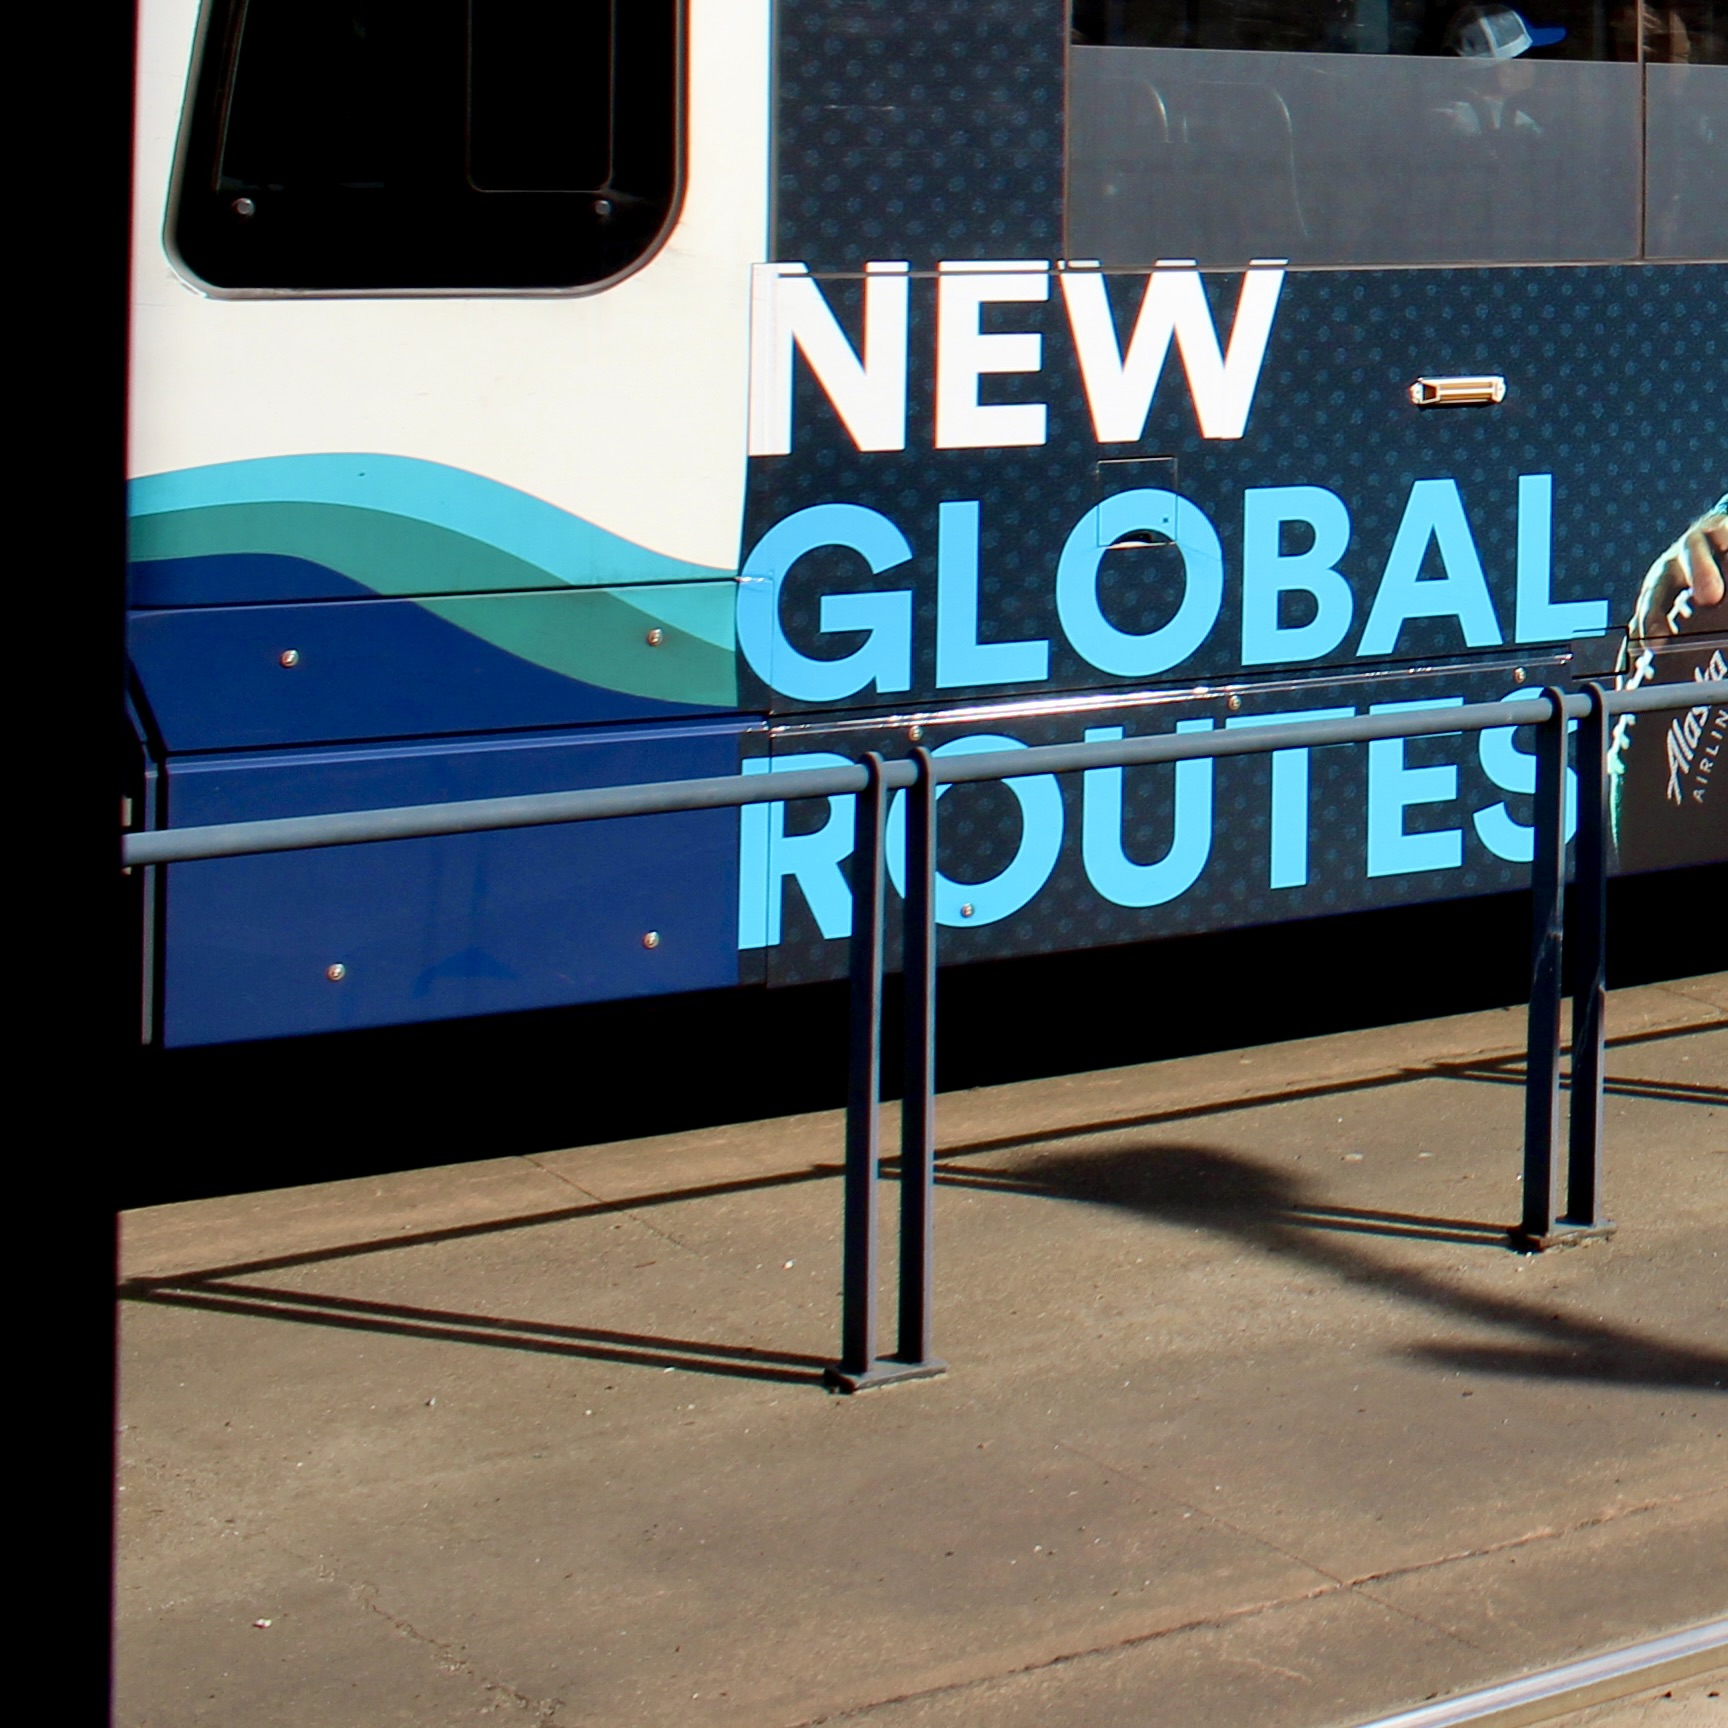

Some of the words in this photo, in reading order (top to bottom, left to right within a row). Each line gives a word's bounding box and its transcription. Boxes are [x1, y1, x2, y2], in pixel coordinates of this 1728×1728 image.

[748, 258, 1289, 456] NEW
[735, 473, 1609, 702] GLOBAL
[737, 686, 1579, 951] ROUTES
